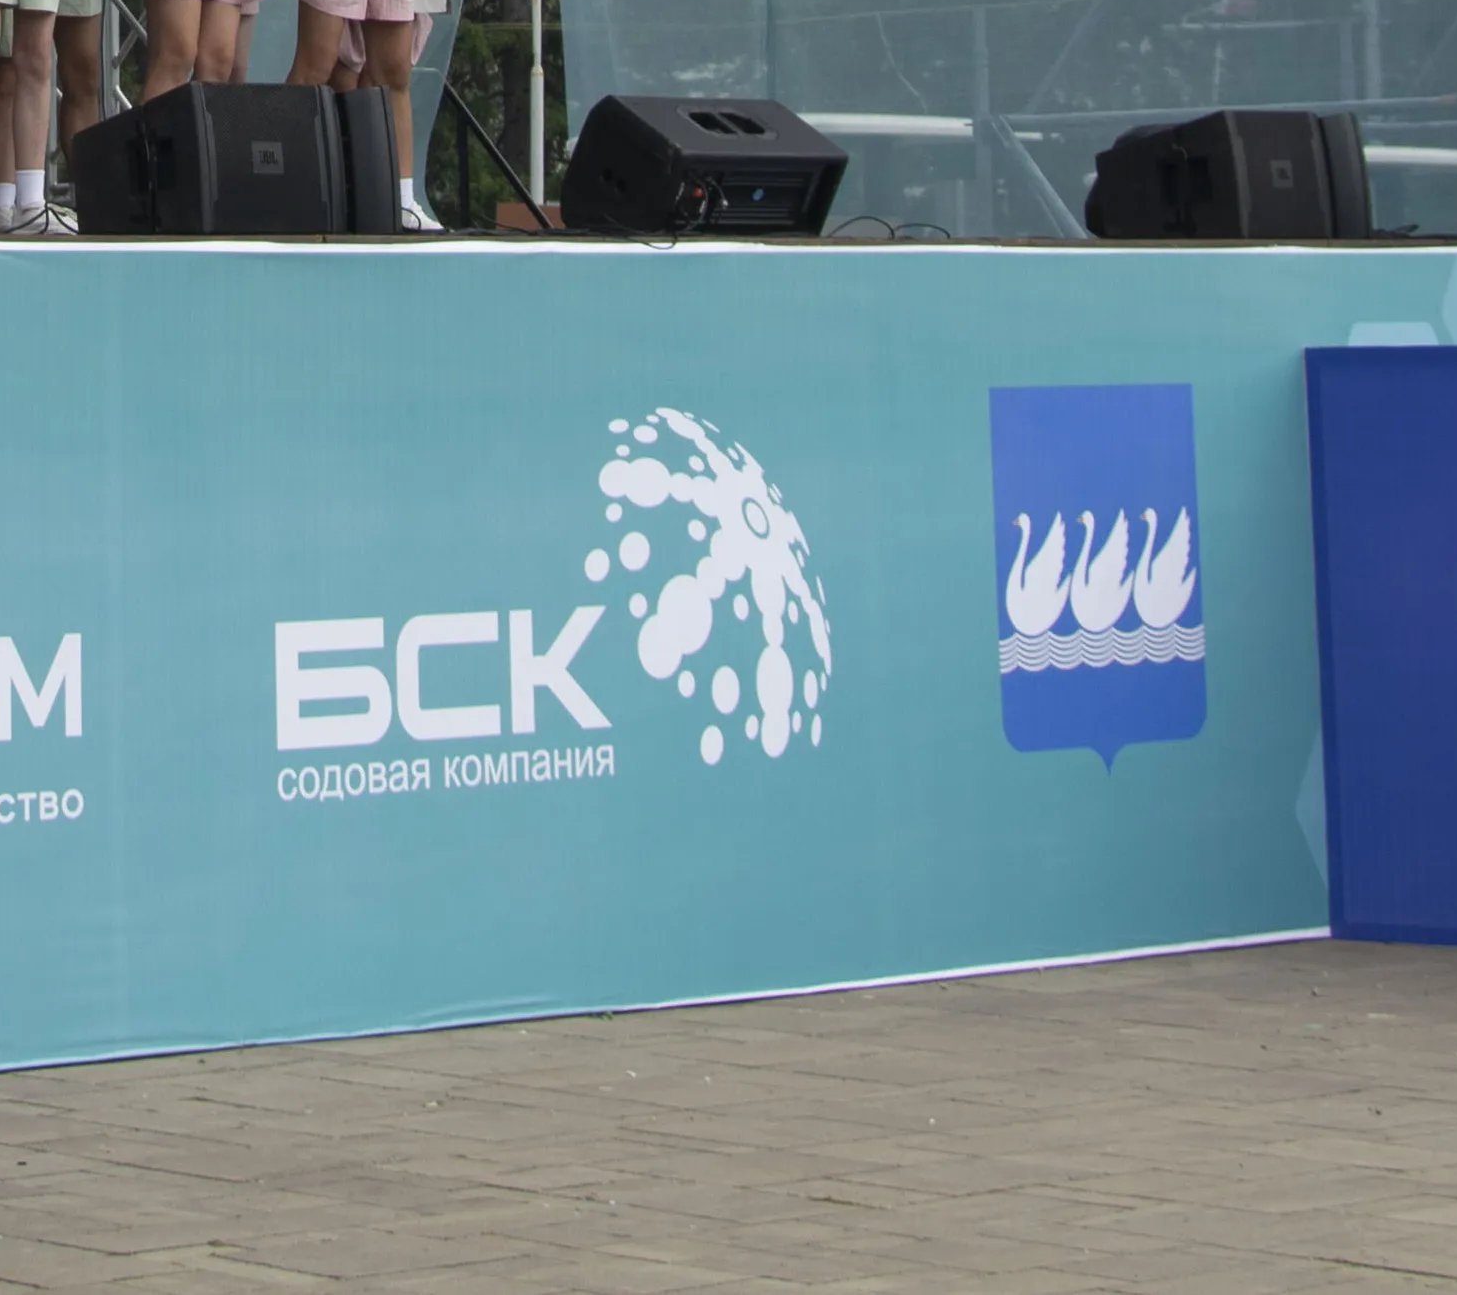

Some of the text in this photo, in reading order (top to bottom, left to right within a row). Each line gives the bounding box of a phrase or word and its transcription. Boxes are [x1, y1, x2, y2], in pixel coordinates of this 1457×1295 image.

[274, 605, 613, 751] БСК
[277, 745, 616, 802] содовая компания
